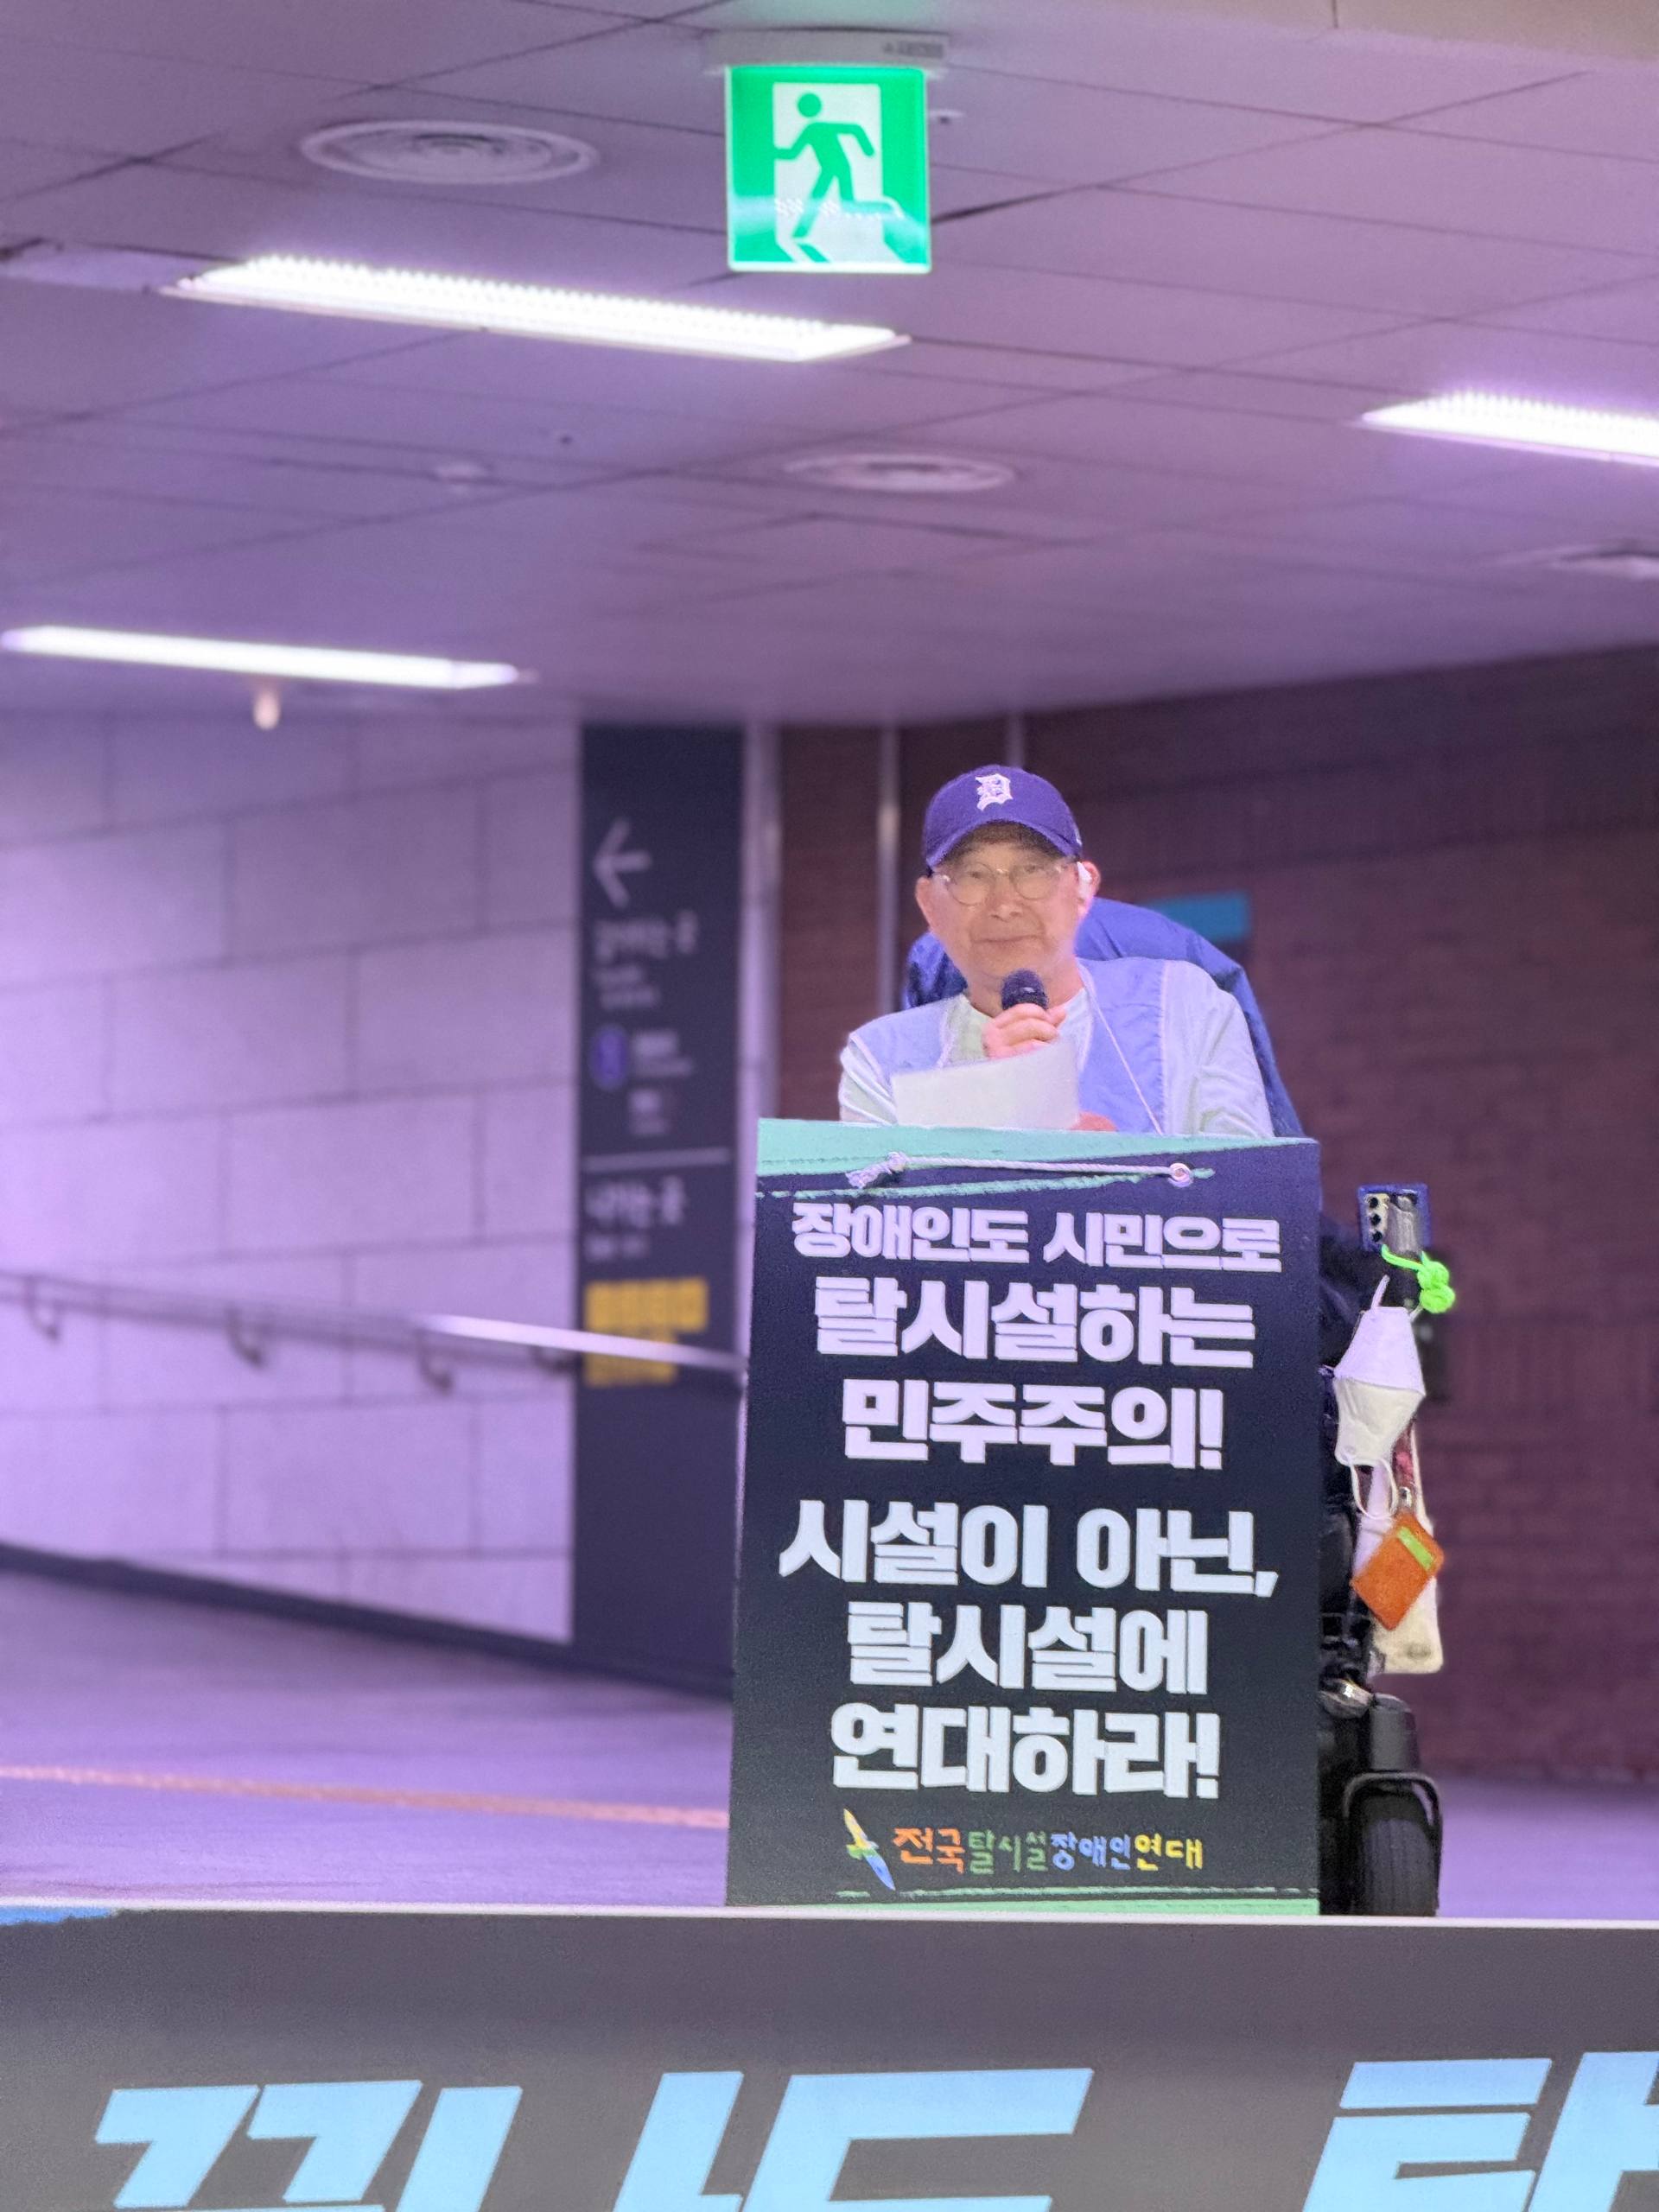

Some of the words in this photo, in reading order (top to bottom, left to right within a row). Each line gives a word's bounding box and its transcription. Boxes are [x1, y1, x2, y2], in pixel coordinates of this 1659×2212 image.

[792, 1202, 1030, 1263] 장애인도
[1042, 1211, 1281, 1273] 시민으로
[815, 1276, 1255, 1368] 탈시설하는
[842, 1378, 1224, 1470] 민주주의!
[779, 1499, 1048, 1588] 시설이
[1076, 1508, 1279, 1598] 아닌,
[847, 1600, 1209, 1694] 탈시설에
[830, 1701, 1220, 1799] 연대하라!
